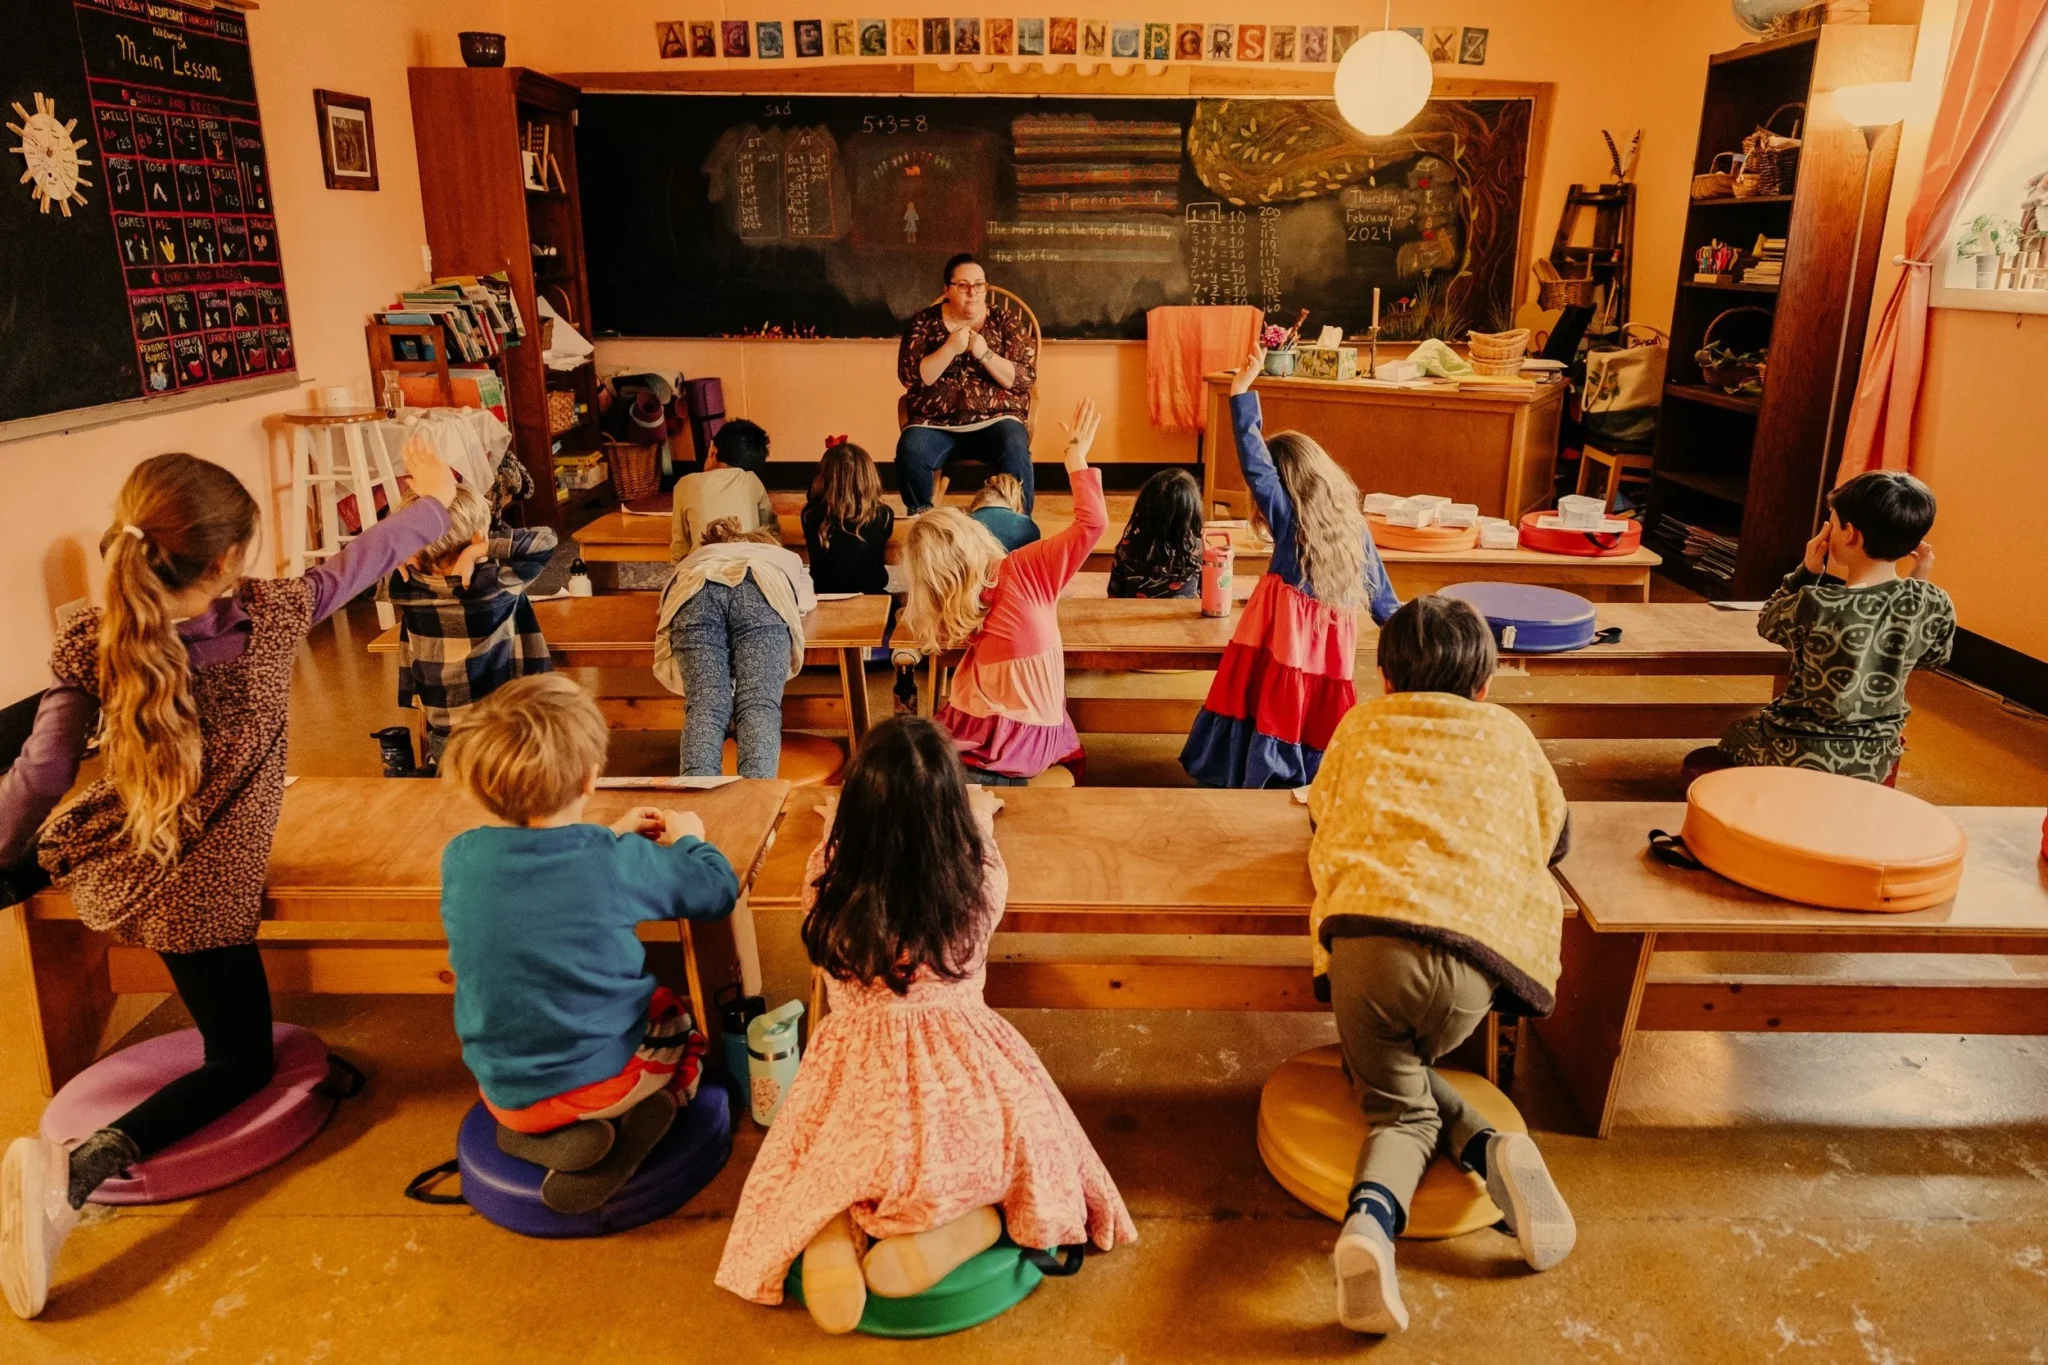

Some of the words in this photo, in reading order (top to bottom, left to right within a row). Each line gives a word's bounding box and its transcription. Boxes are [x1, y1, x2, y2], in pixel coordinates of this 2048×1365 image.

[215, 20, 243, 37] FRIDAY
[662, 24, 685, 57] A
[759, 26, 782, 57] D
[799, 24, 818, 56] E
[861, 25, 886, 53] G
[1085, 25, 1106, 52] N
[1150, 27, 1168, 60] P
[1212, 29, 1233, 58] R
[1243, 28, 1263, 59] S
[1273, 31, 1295, 60] T
[1462, 32, 1486, 62] Z
[115, 34, 164, 71] Main
[172, 44, 222, 82] Lesson
[169, 98, 186, 111] AND
[763, 100, 792, 117] sad
[100, 110, 129, 123] SKILLS
[136, 114, 162, 125] SKILLS
[171, 117, 195, 128] SKILLS
[200, 120, 219, 130] EXTRA
[116, 137, 132, 151] 123
[748, 137, 762, 148] ET
[800, 135, 813, 146] AT
[109, 158, 133, 170] MUSIC
[809, 152, 827, 164] hat
[144, 163, 167, 173] YOGA
[179, 163, 202, 175] MUSIC
[212, 169, 236, 180] SKILLS
[225, 194, 240, 207] 123
[1350, 190, 1401, 206] Thursday,
[1229, 210, 1246, 224] 10
[1258, 206, 1281, 218] 200
[1346, 209, 1394, 227] February
[118, 217, 146, 229] GAMES
[155, 220, 172, 230] ASL
[187, 218, 212, 230] GAMES
[987, 221, 1007, 235] The
[1011, 225, 1034, 235] men
[1037, 224, 1055, 235] sat
[1072, 223, 1086, 235] the
[1089, 225, 1105, 240] top
[1107, 224, 1118, 235] of
[1121, 223, 1136, 236] the
[1160, 225, 1172, 240] by
[1229, 225, 1245, 234] 10
[1347, 226, 1392, 241] 2024
[1229, 237, 1244, 248] 10
[995, 251, 1013, 263] the
[1017, 250, 1037, 262] hot
[1229, 249, 1244, 259] 10
[1229, 262, 1245, 273] 10
[196, 270, 212, 280] AND
[1232, 274, 1246, 285] 10
[1232, 285, 1248, 297] 10
[173, 302, 190, 312] WALK
[207, 332, 232, 345] SPANISH
[236, 330, 251, 339] CLEAN
[265, 329, 278, 337] CLEAN
[174, 338, 190, 349] CLEAN
[270, 336, 285, 345] STORY
[140, 341, 168, 353] READING
[179, 346, 198, 357] STORY
